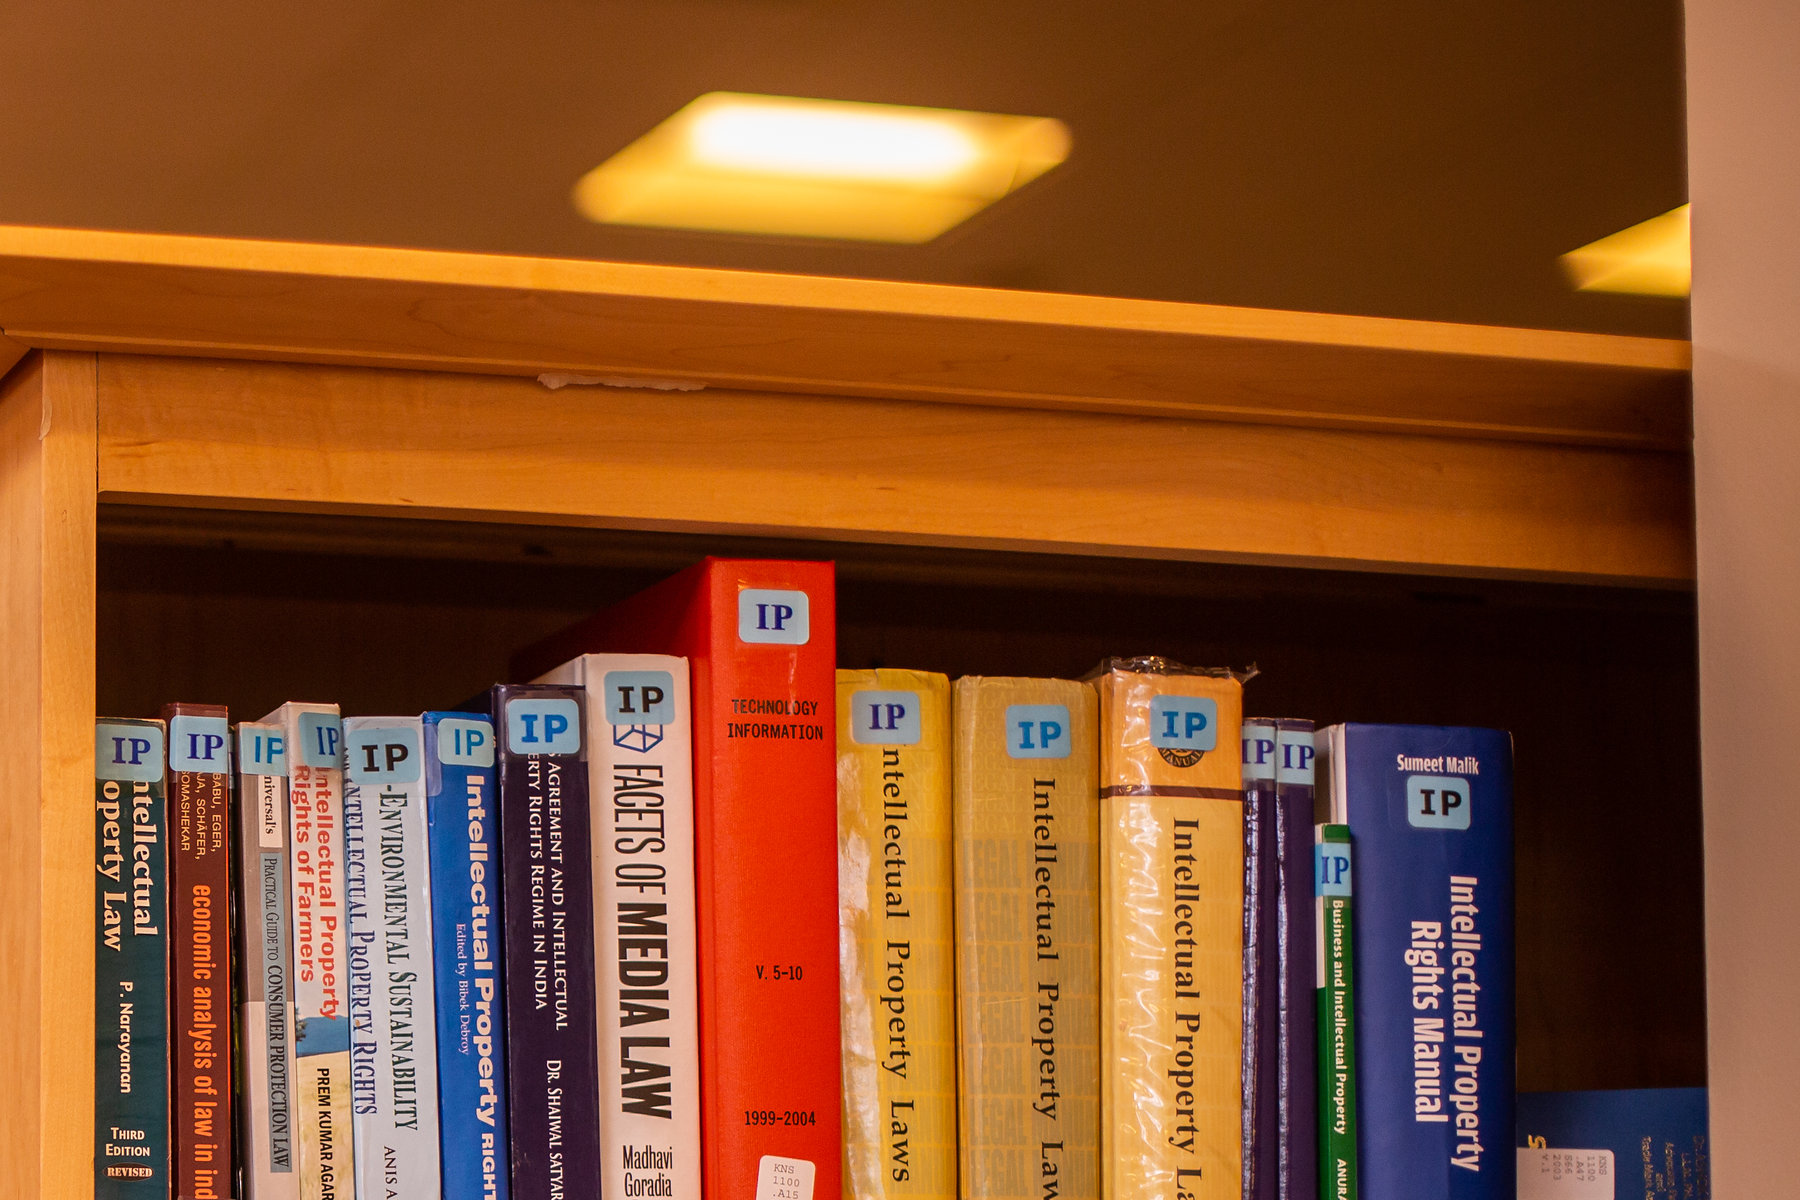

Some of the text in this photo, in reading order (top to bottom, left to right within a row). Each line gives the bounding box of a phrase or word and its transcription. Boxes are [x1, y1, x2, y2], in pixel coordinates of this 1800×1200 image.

[756, 604, 792, 631] IP
[618, 686, 664, 713] IP
[731, 699, 818, 716] TECHNOLOGY
[455, 729, 484, 755] IP
[521, 714, 567, 743] IP
[728, 723, 823, 741] INFORMATION
[1018, 721, 1062, 749] IP
[1162, 711, 1207, 738] IP
[112, 737, 151, 765] IP
[187, 733, 223, 760] IP
[361, 744, 409, 771] IP
[1397, 754, 1479, 775] Sumeet Malik
[1420, 789, 1462, 816] IP
[291, 766, 315, 982] Rights of Farmers
[1034, 777, 1059, 962] Intellectual
[1321, 856, 1348, 884] IP
[529, 796, 548, 1010] RIGHTS REGIME IN INDIA
[548, 762, 567, 1031] AGREEMENT AND INTELLECTUAL
[103, 892, 127, 951] Law
[193, 885, 216, 980] economic
[466, 775, 499, 1127] Intellectual Property
[613, 764, 672, 1120] FACETS OF MEDIA LAW
[318, 916, 340, 1020] Property
[756, 965, 803, 981] V. 5-10
[1167, 817, 1201, 1154] Intellectual Property
[455, 924, 470, 1055] Edited by Bibek Debroy
[188, 986, 217, 1069] analysis
[264, 858, 289, 1168] PRACTICAL GUIDE CONSUMER PROTECTION LAW
[1333, 900, 1348, 1135] Business and Intellectual Property
[1404, 920, 1448, 1123] Rights Manual
[1450, 875, 1483, 1172] Intellectual Property
[117, 1003, 133, 1093] Narayanan
[388, 971, 417, 1131] SUSTAINABILITY
[879, 940, 914, 1183] Property Laws
[1031, 981, 1061, 1121] Property
[194, 1075, 217, 1093] of
[353, 1040, 377, 1115] RIGHTS
[194, 1101, 217, 1137] law
[317, 1068, 332, 1162] PREM KUMAR
[546, 1060, 563, 1149] DR. SHAIWAL
[745, 1111, 816, 1127] 1999-2004
[105, 1144, 150, 1157] EDITION
[111, 1127, 145, 1140] THIRD
[107, 1167, 153, 1177] REVISED
[195, 1145, 217, 1162] in
[384, 1146, 398, 1184] ANIS
[622, 1145, 673, 1170] Madhavi
[624, 1172, 672, 1197] Goradia
